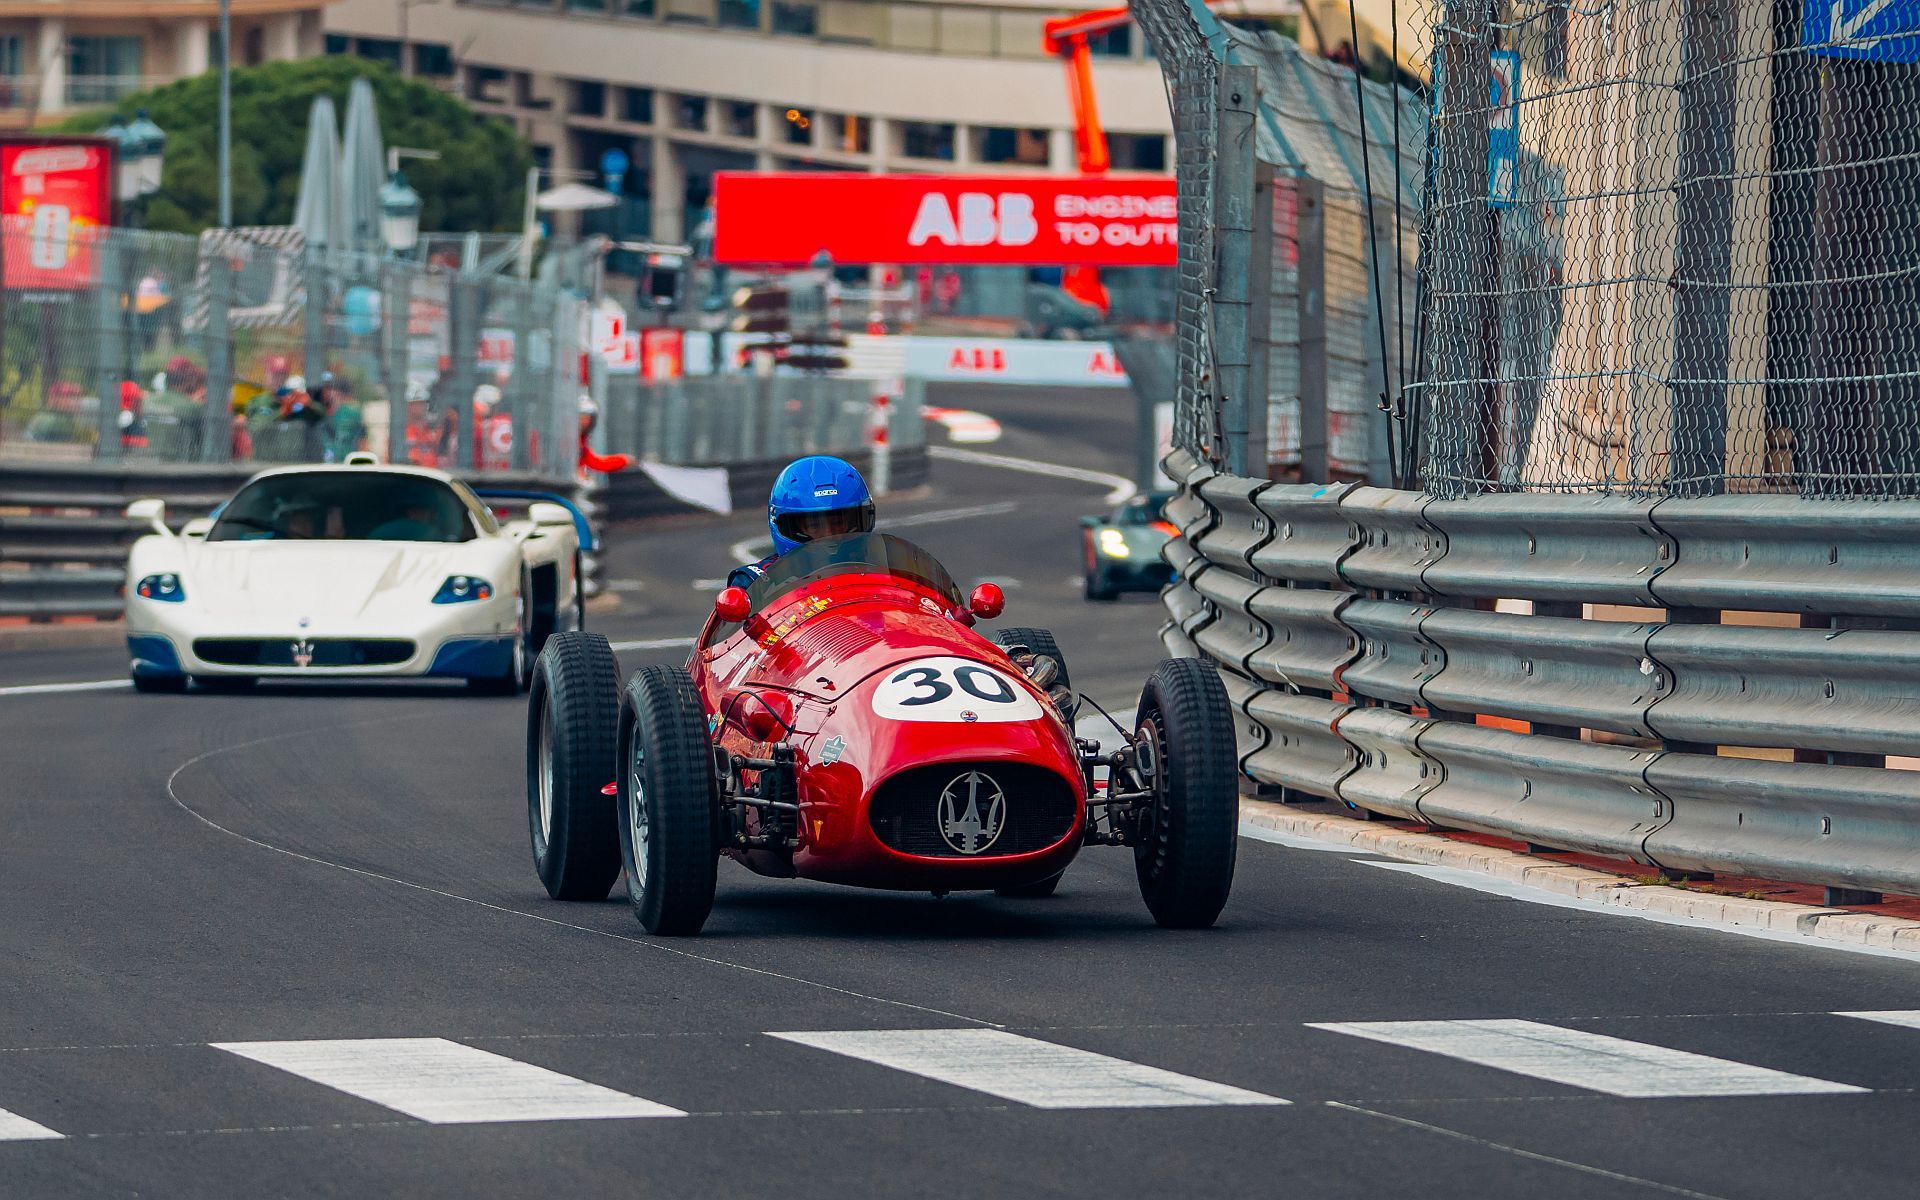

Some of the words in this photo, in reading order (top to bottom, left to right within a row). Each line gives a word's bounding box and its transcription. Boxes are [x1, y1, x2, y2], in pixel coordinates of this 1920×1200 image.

[908, 192, 1038, 246] ABB
[1056, 223, 1100, 245] TO
[950, 348, 1005, 371] ABB
[891, 665, 1017, 706] 30
